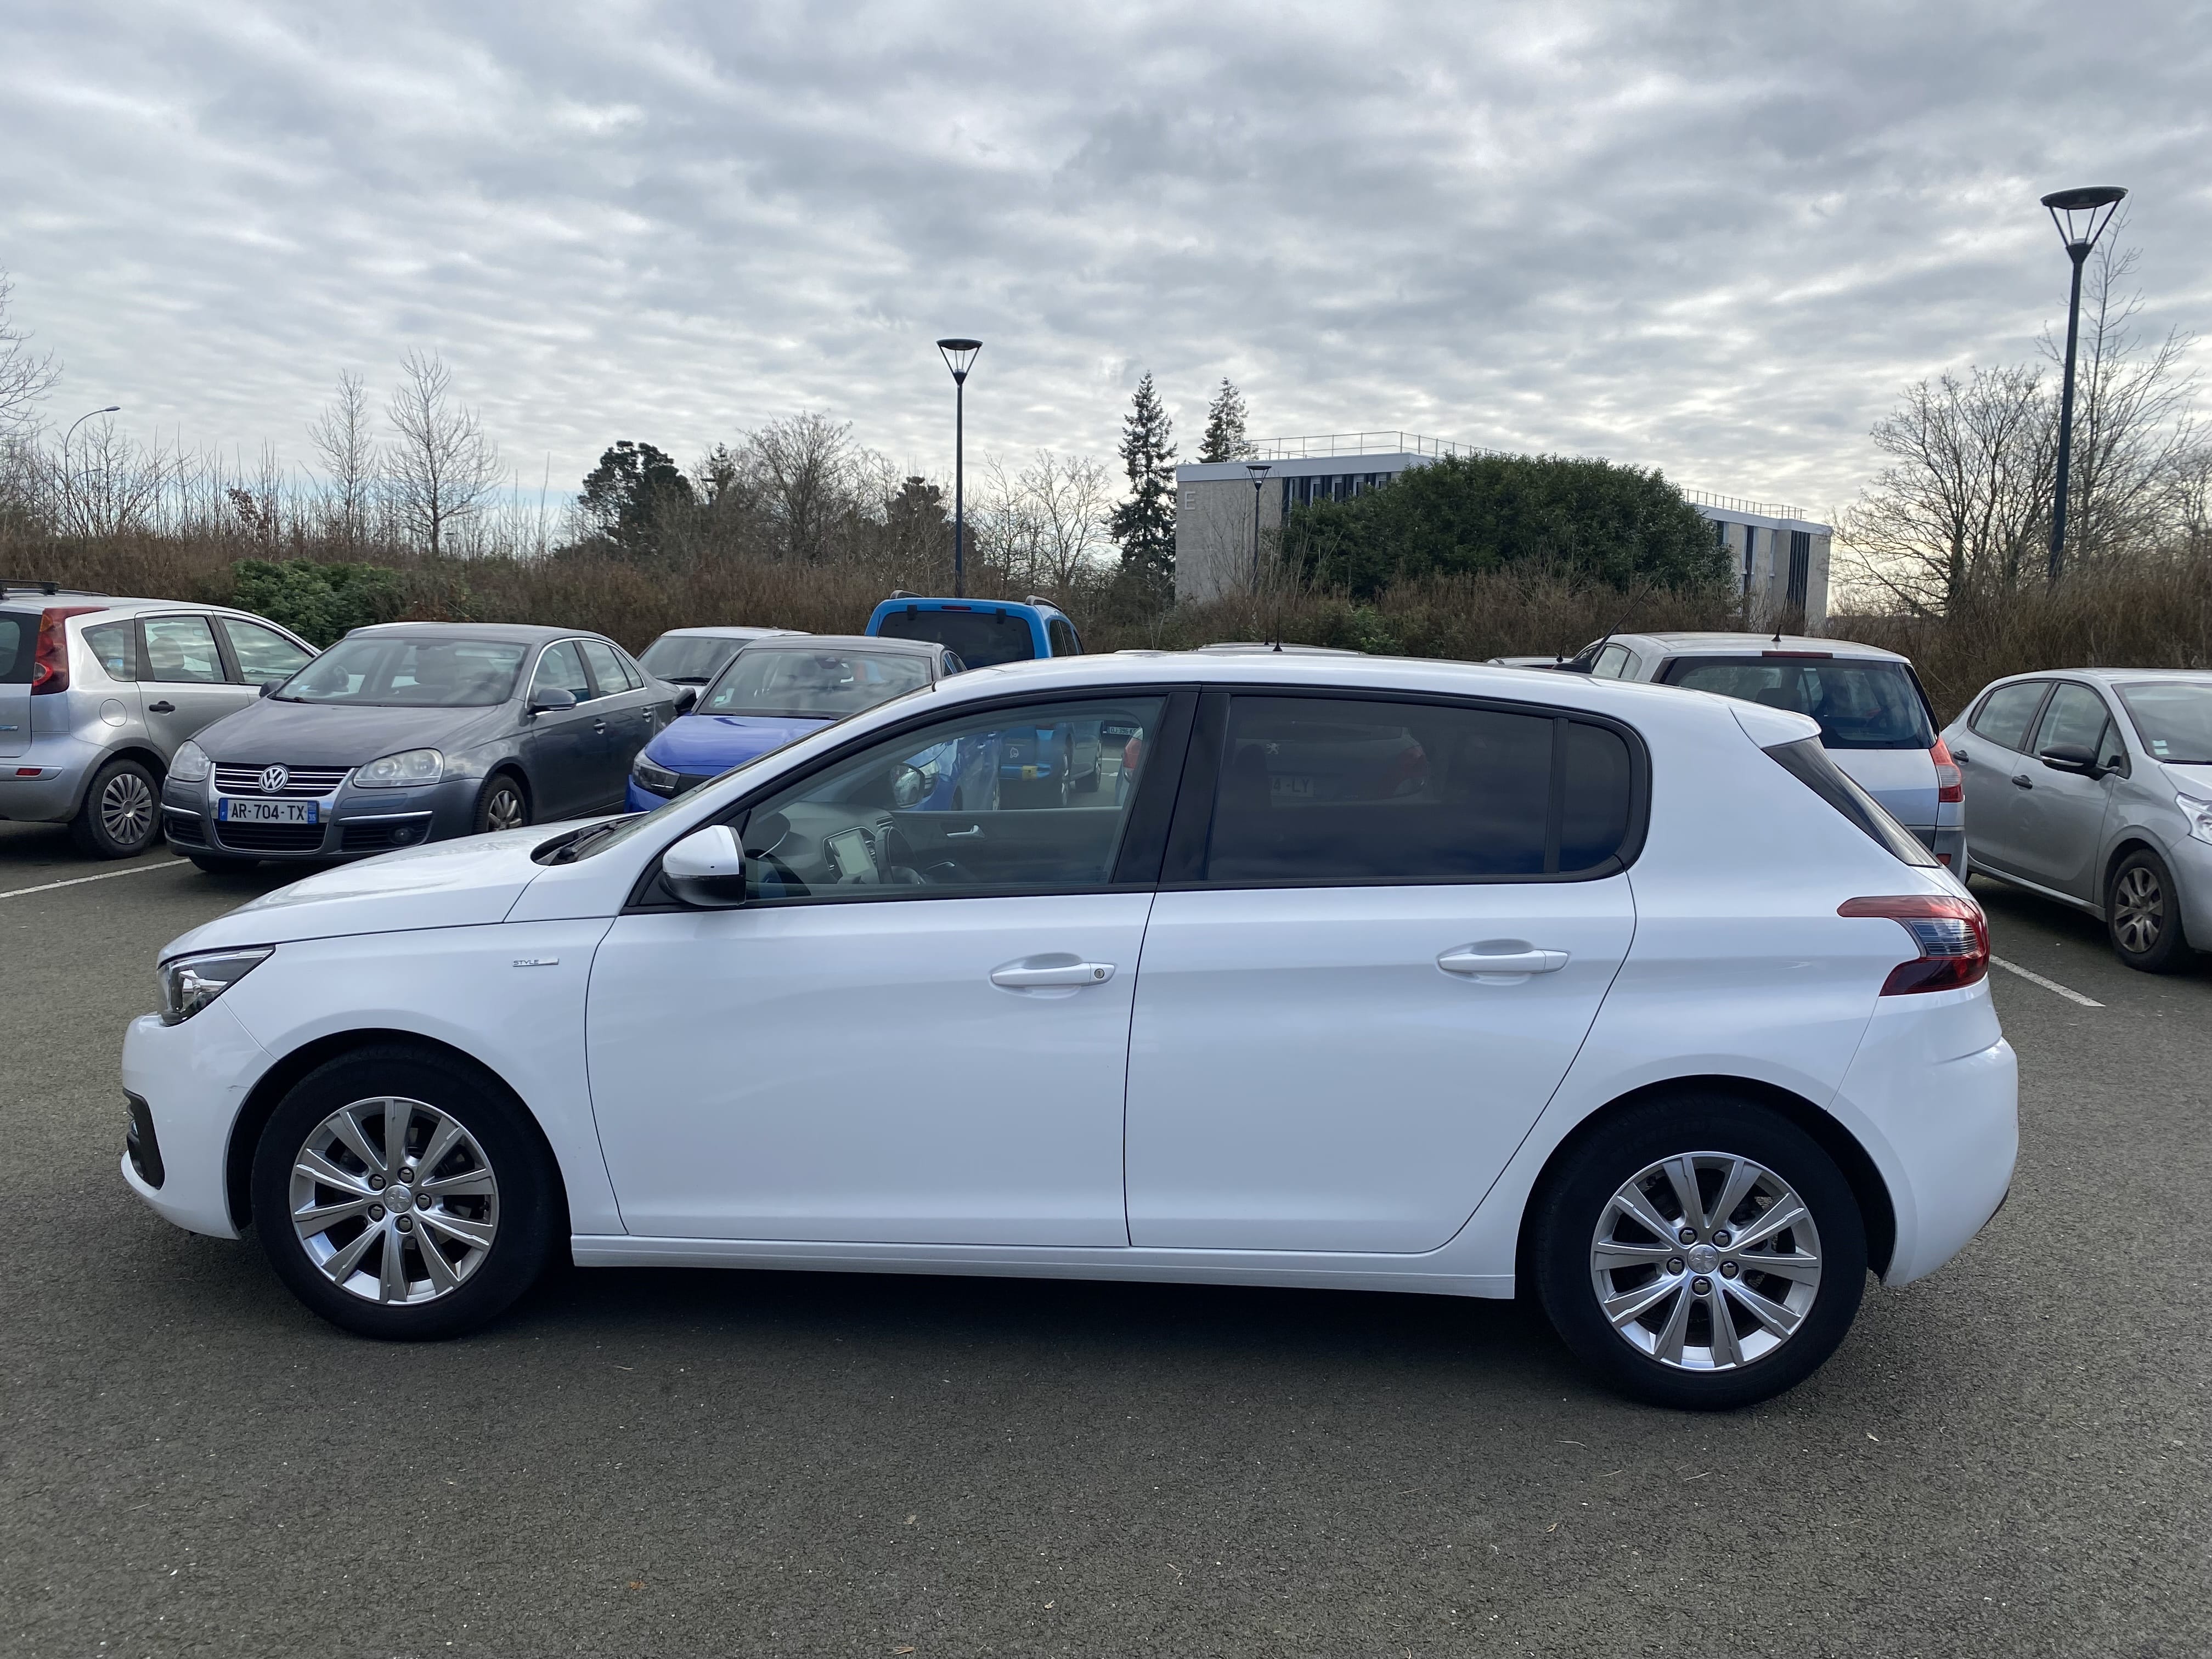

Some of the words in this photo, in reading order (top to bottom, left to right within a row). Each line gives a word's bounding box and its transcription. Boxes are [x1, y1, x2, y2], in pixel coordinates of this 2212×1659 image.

[1184, 491, 1196, 510] E
[259, 766, 287, 792] VW
[1269, 777, 1310, 793] 4-LY
[231, 803, 305, 821] AR-704-TX
